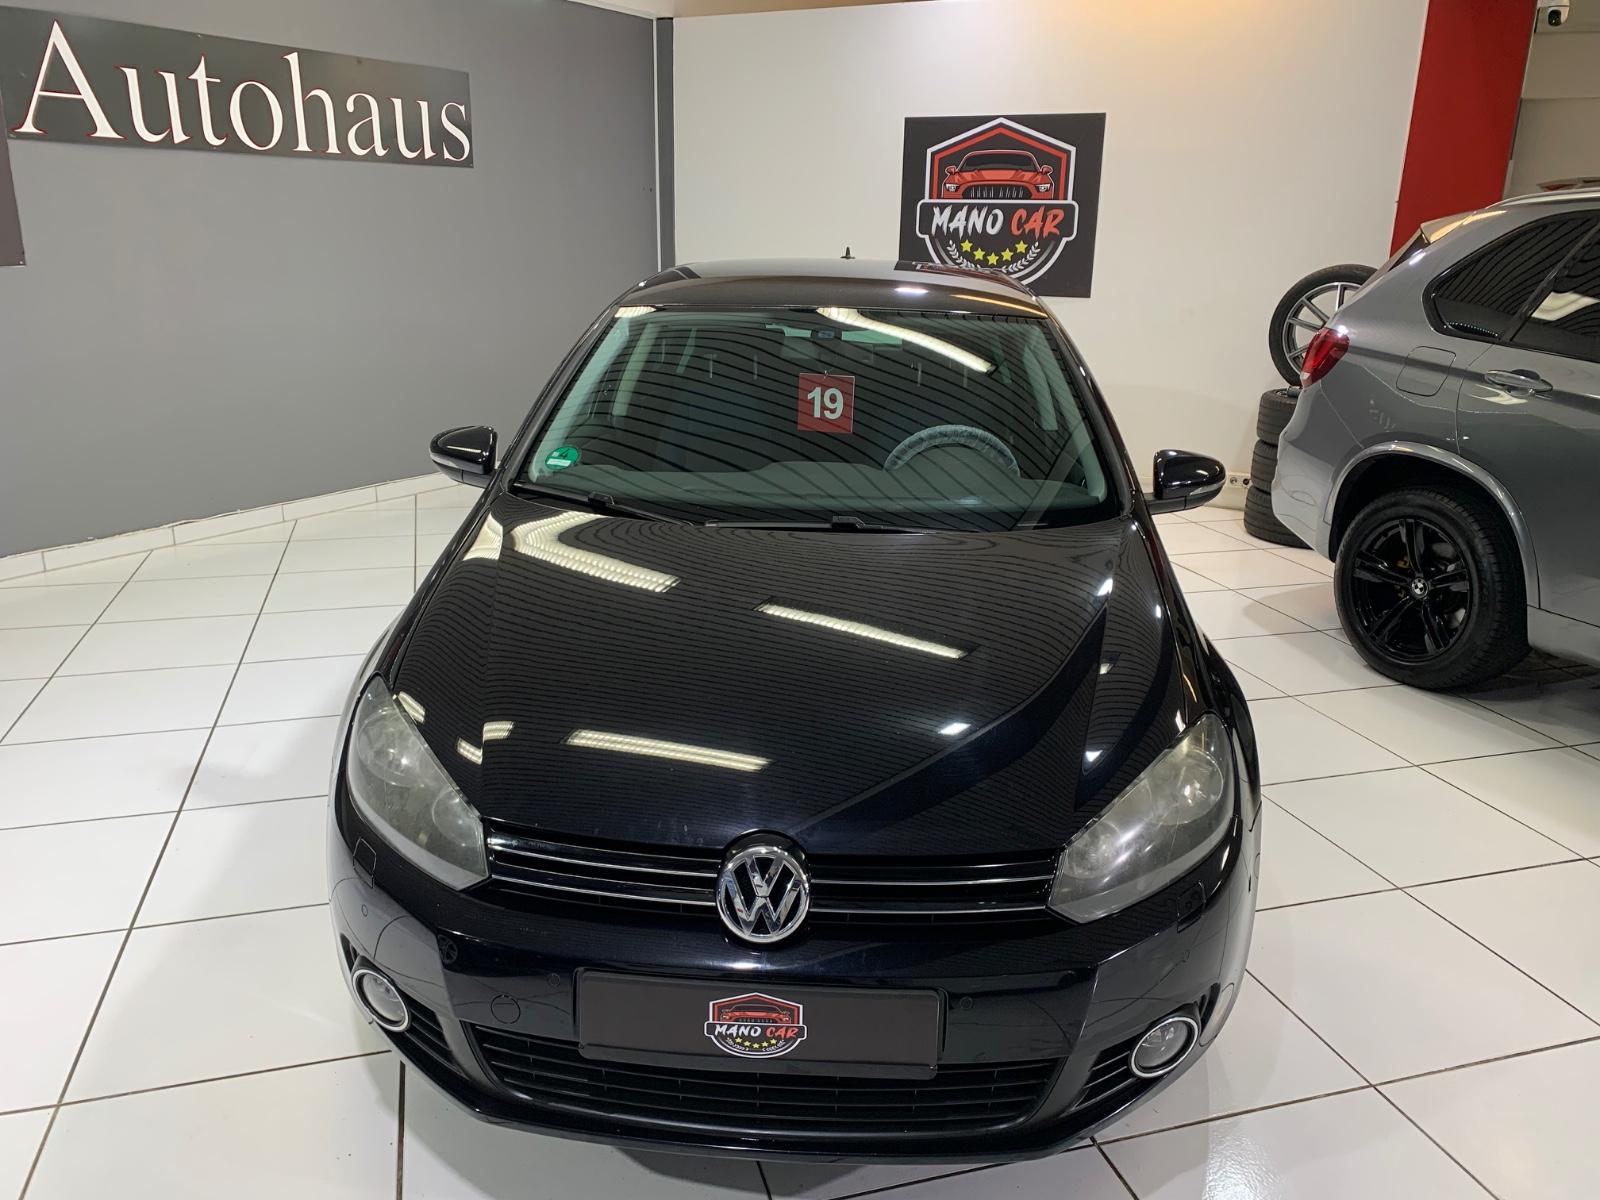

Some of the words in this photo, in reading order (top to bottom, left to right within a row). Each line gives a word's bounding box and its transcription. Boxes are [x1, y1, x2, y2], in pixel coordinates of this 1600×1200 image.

[13, 19, 472, 162] Autohaus
[931, 204, 1004, 240] MANO
[1011, 206, 1065, 240] CAR
[807, 386, 844, 420] 19
[714, 1024, 761, 1038] MANO
[766, 1026, 799, 1039] CAR
